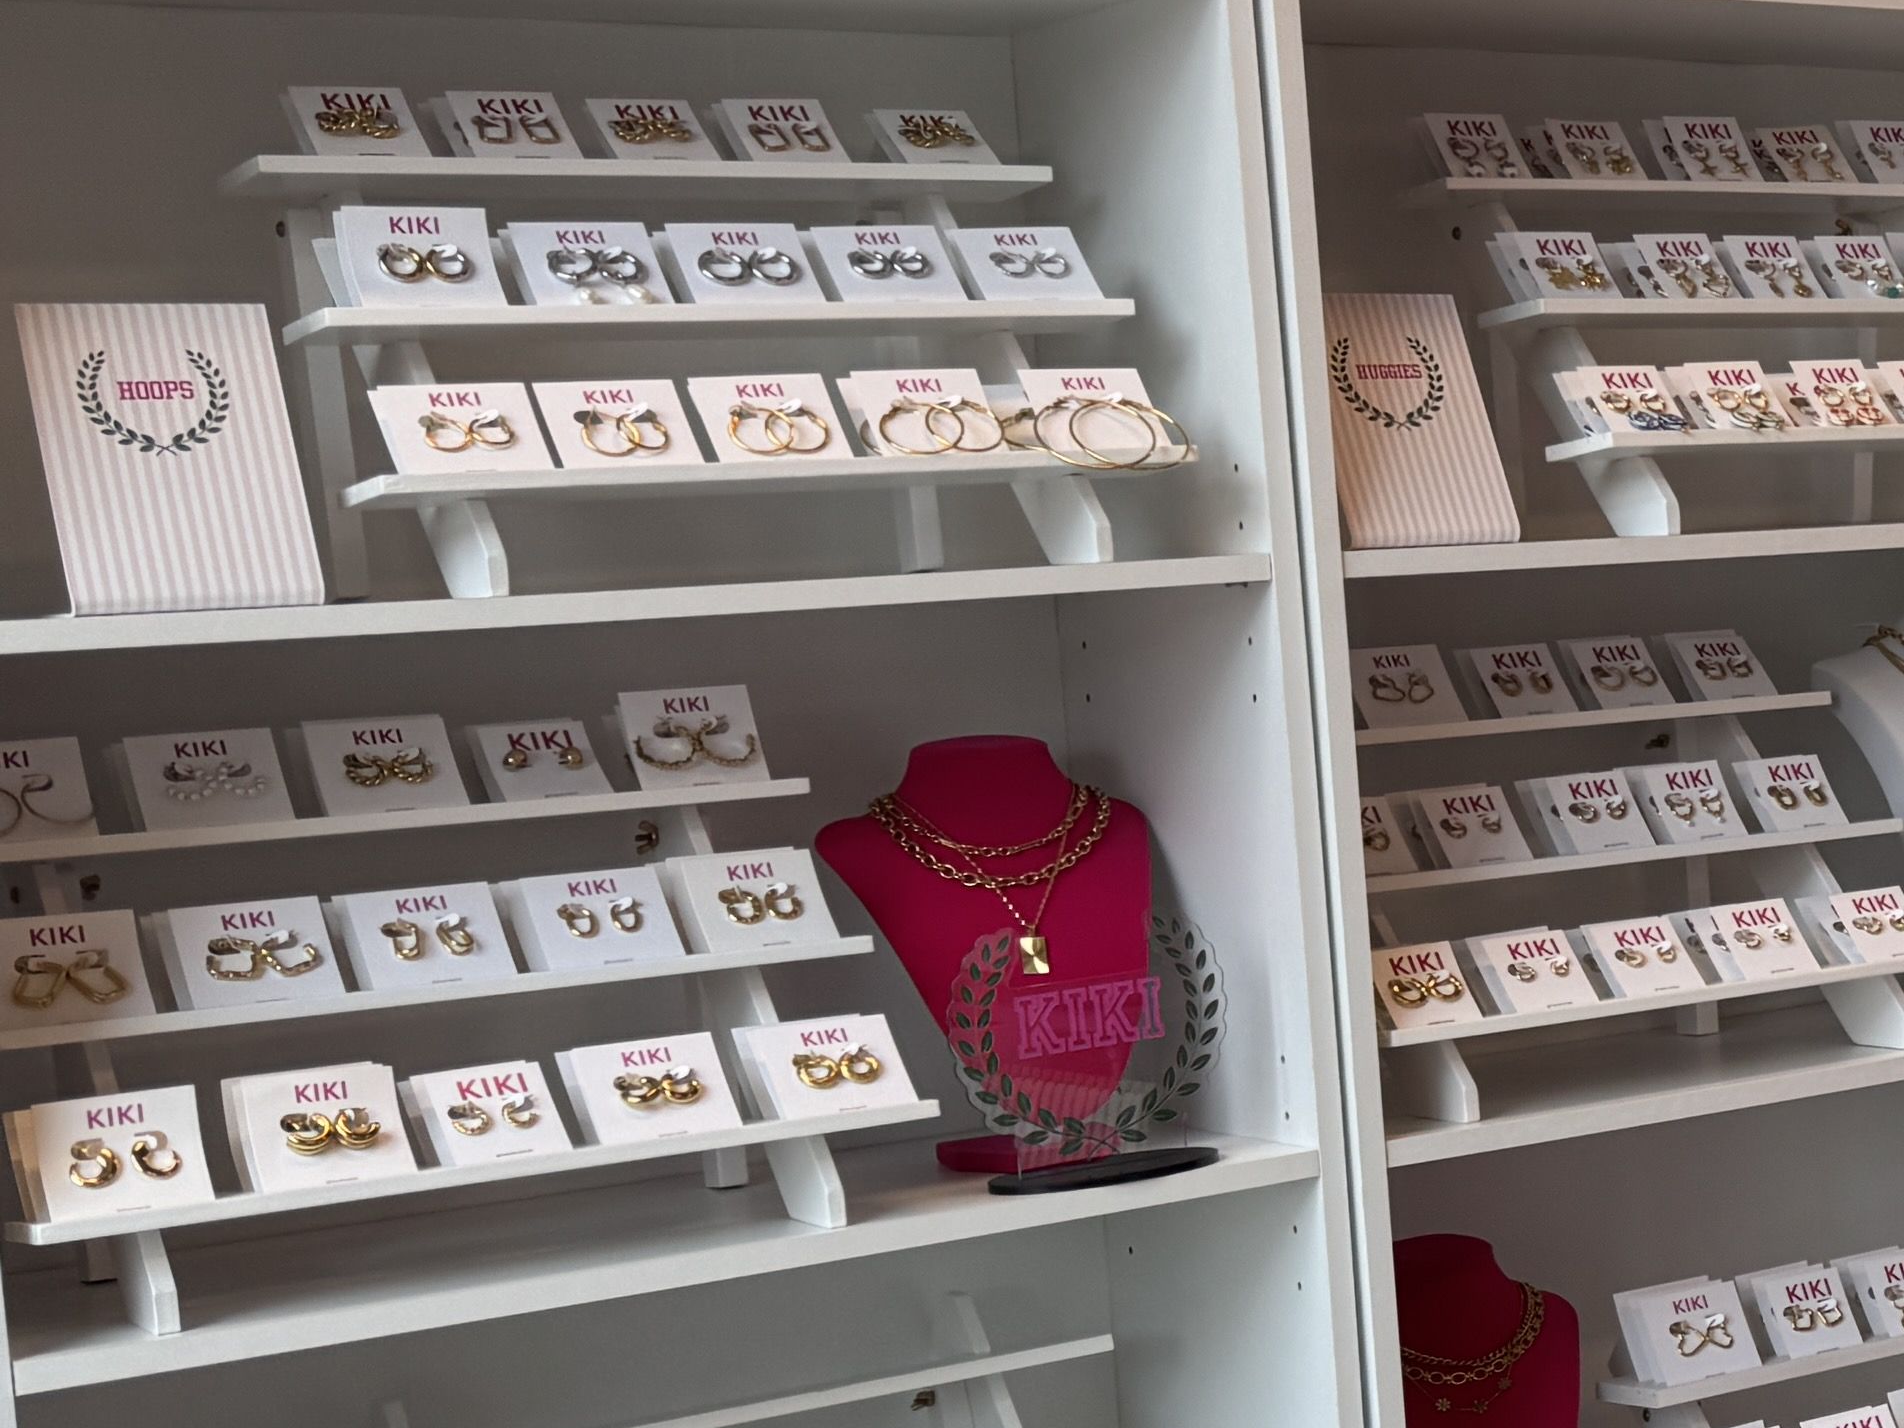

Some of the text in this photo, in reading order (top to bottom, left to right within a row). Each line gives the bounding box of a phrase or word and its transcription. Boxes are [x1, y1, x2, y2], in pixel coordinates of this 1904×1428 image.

[477, 97, 543, 116] KIKI
[748, 105, 810, 123] KIKI
[1447, 120, 1495, 137] KIKI
[1685, 123, 1732, 140] KIKI
[389, 216, 440, 235] KIKI
[555, 230, 605, 247] KIKI
[855, 232, 900, 247] KIKI
[994, 234, 1038, 247] KIKI
[1657, 241, 1702, 258] KIKI
[1836, 243, 1881, 259] KIKI
[1355, 364, 1423, 380] HUGGIES
[1602, 373, 1652, 389] KIKI
[1812, 368, 1859, 384] KIKI
[117, 380, 195, 402] HOOPS
[735, 383, 784, 399] KIKI
[895, 377, 942, 393] KIKI
[429, 391, 481, 407] KIKI
[583, 388, 634, 405] KIKI
[1694, 642, 1740, 660] KIKI
[1492, 651, 1542, 671] KIKI
[663, 697, 710, 714] KIKI
[353, 728, 402, 746] KIKI
[508, 730, 572, 752] KIKI
[174, 740, 228, 757] KIKI
[1768, 763, 1814, 783] KIKI
[1568, 780, 1616, 801] KIKI
[727, 863, 774, 881] KIKI
[568, 879, 618, 897] KIKI
[222, 911, 275, 931] KIKI
[1732, 907, 1781, 929] KIKI
[30, 926, 85, 946] KIKI
[1507, 938, 1561, 961] KIKI
[1012, 976, 1165, 1060] KIKI
[621, 1048, 672, 1066] KIKI
[295, 1081, 348, 1104] KIKI
[457, 1074, 528, 1100] KIKI
[87, 1104, 144, 1128] KIKI
[1673, 1294, 1709, 1315] KIKI
